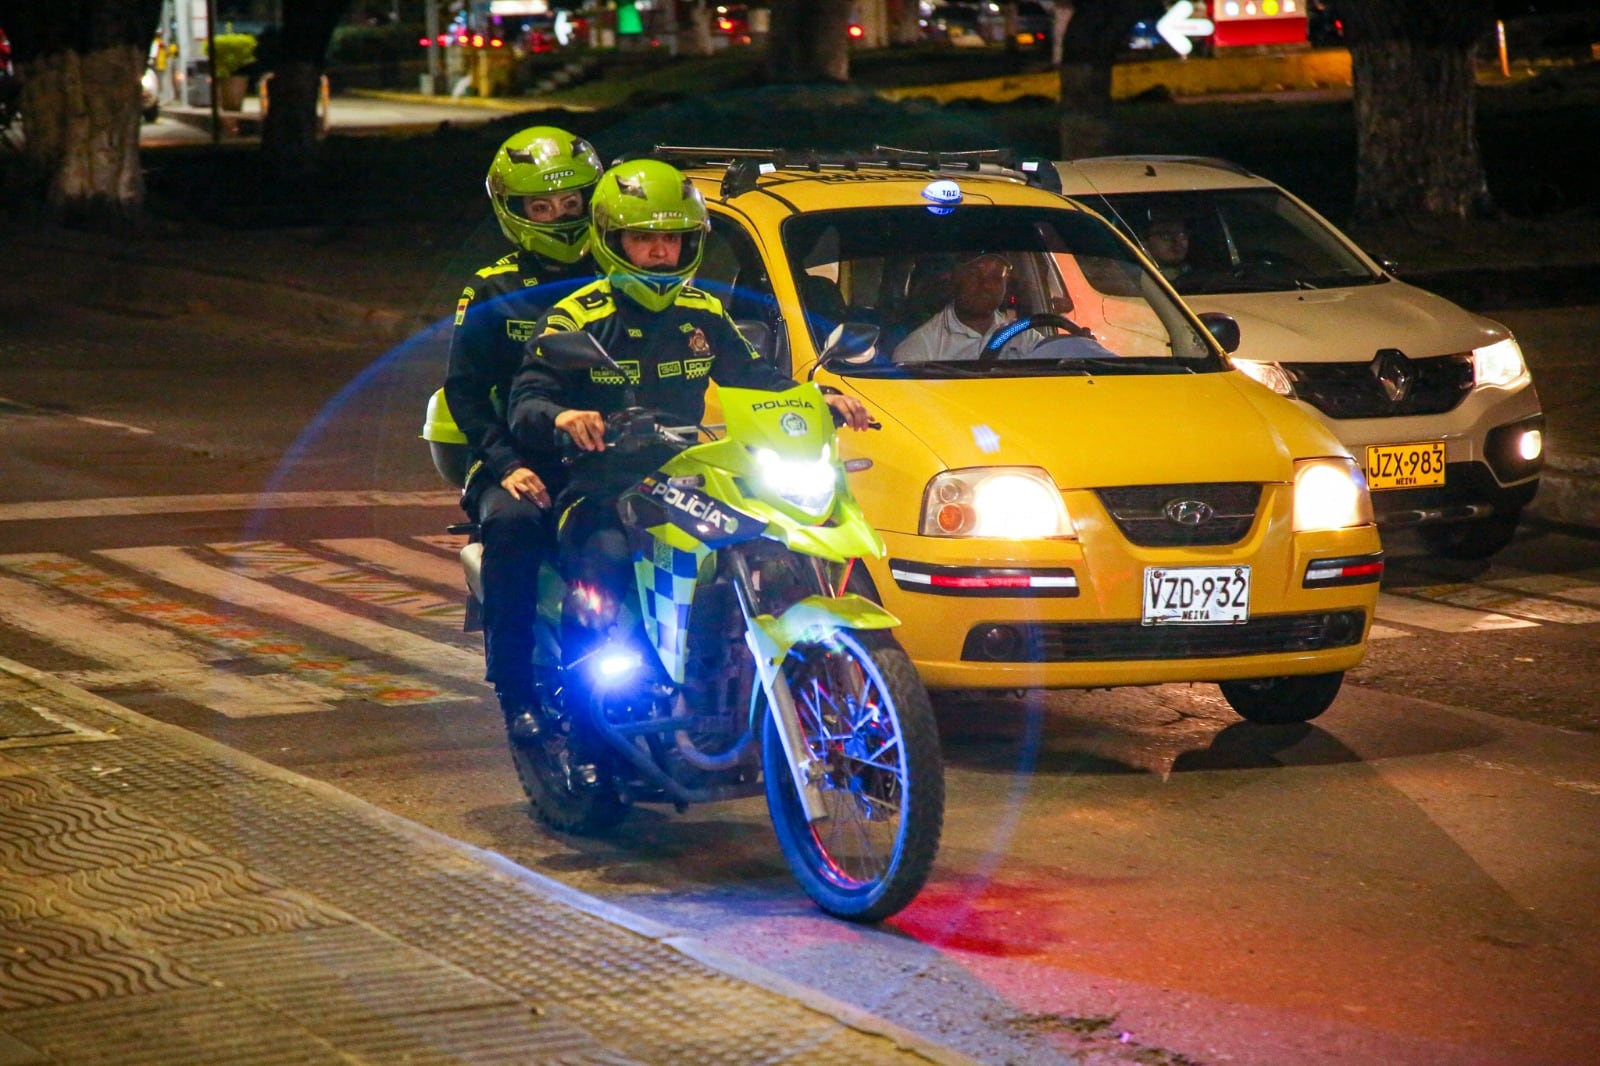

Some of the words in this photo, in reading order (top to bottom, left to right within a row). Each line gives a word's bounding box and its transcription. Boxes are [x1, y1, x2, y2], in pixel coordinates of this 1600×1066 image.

[752, 397, 815, 412] POLICÍA
[1396, 477, 1417, 486] NEIVA
[652, 482, 721, 529] POLICÍA
[1181, 610, 1210, 620] NEIVA
